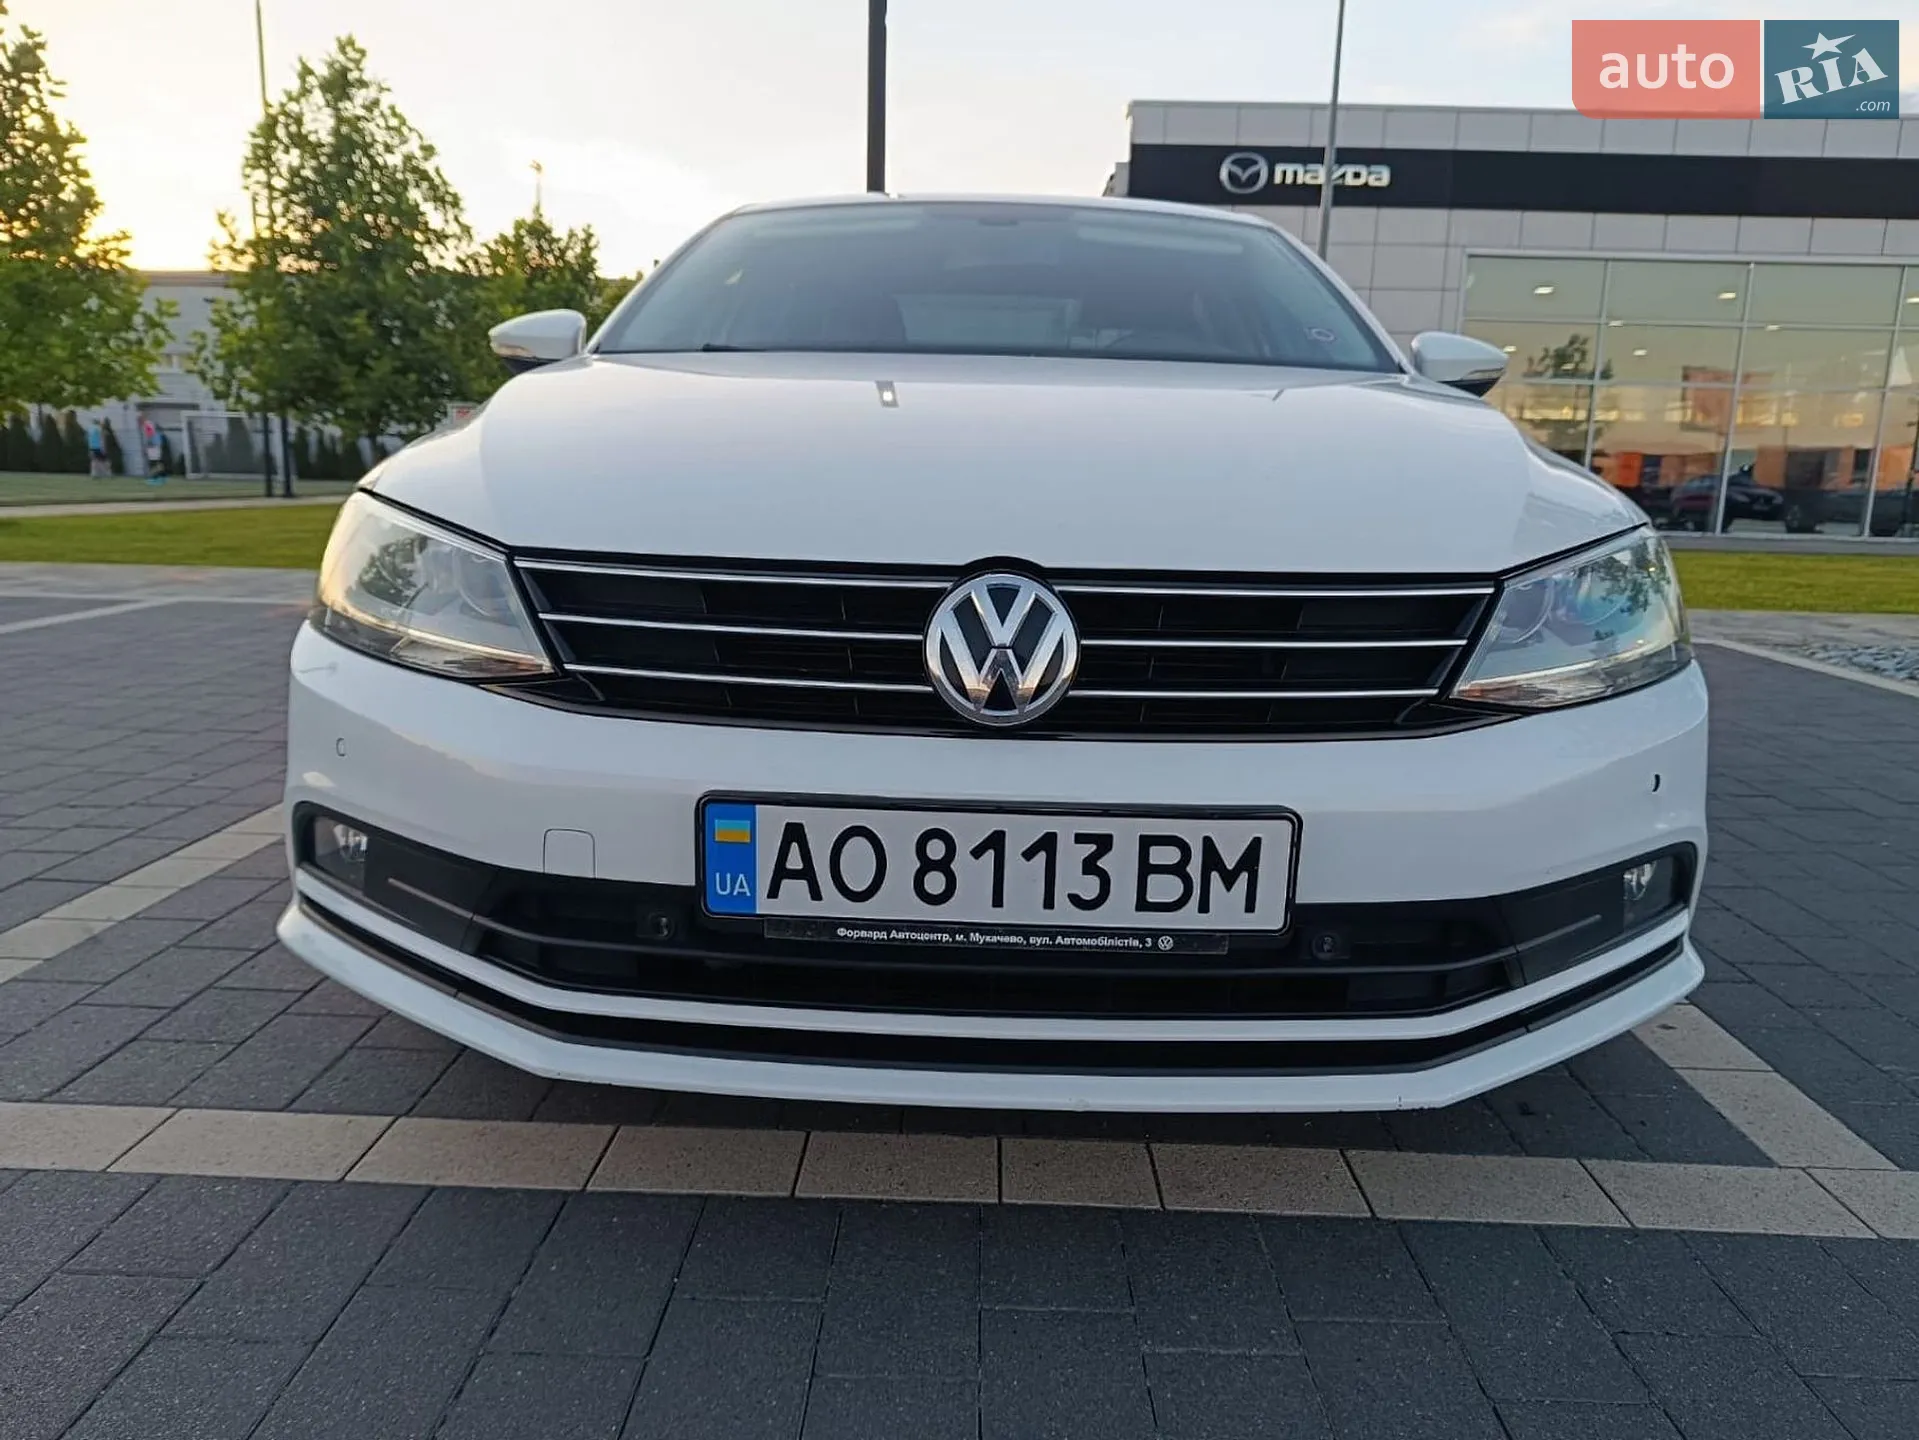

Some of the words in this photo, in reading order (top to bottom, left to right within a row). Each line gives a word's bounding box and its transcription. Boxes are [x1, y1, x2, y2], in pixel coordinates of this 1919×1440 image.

[766, 821, 888, 903] AO
[912, 827, 1114, 912] 8113
[1134, 834, 1263, 915] BM
[714, 872, 751, 897] UA
[837, 927, 887, 940] Форвард
